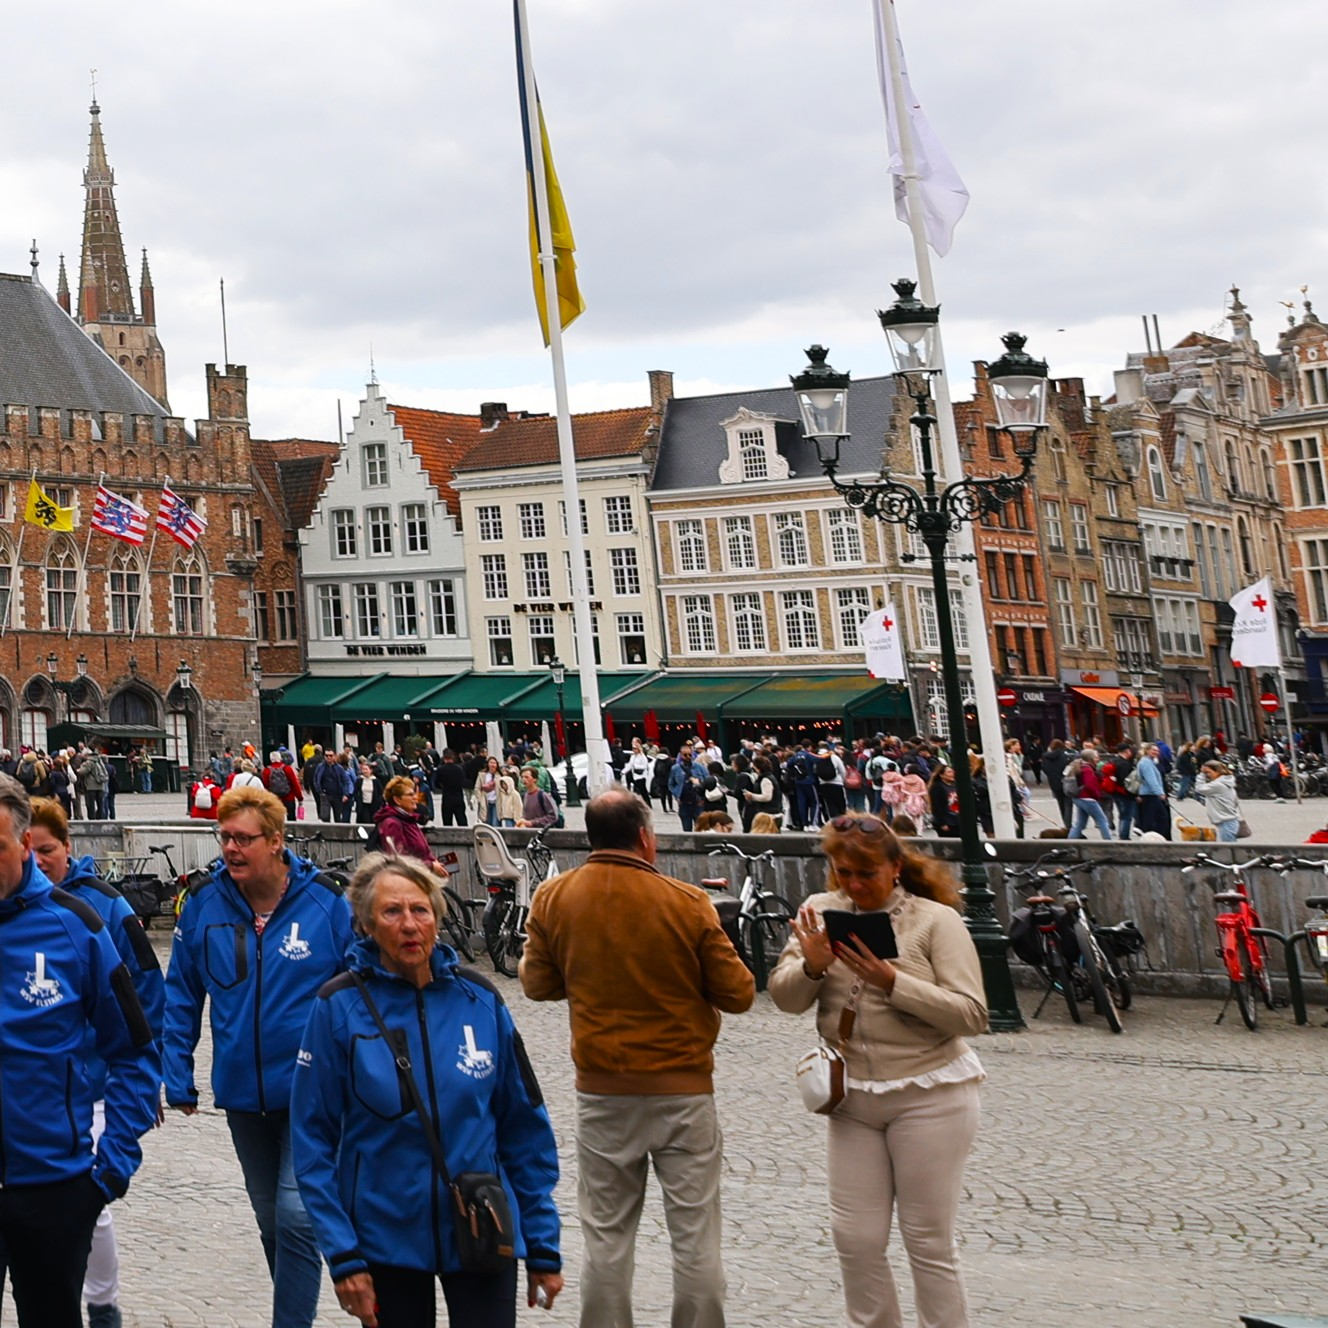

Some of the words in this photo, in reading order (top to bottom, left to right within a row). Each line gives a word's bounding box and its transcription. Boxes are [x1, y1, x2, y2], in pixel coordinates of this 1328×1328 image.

[512, 604, 528, 613] DE
[530, 603, 555, 612] VIER
[347, 645, 359, 656] DE
[362, 645, 385, 656] VIER
[387, 644, 427, 656] WINDEN
